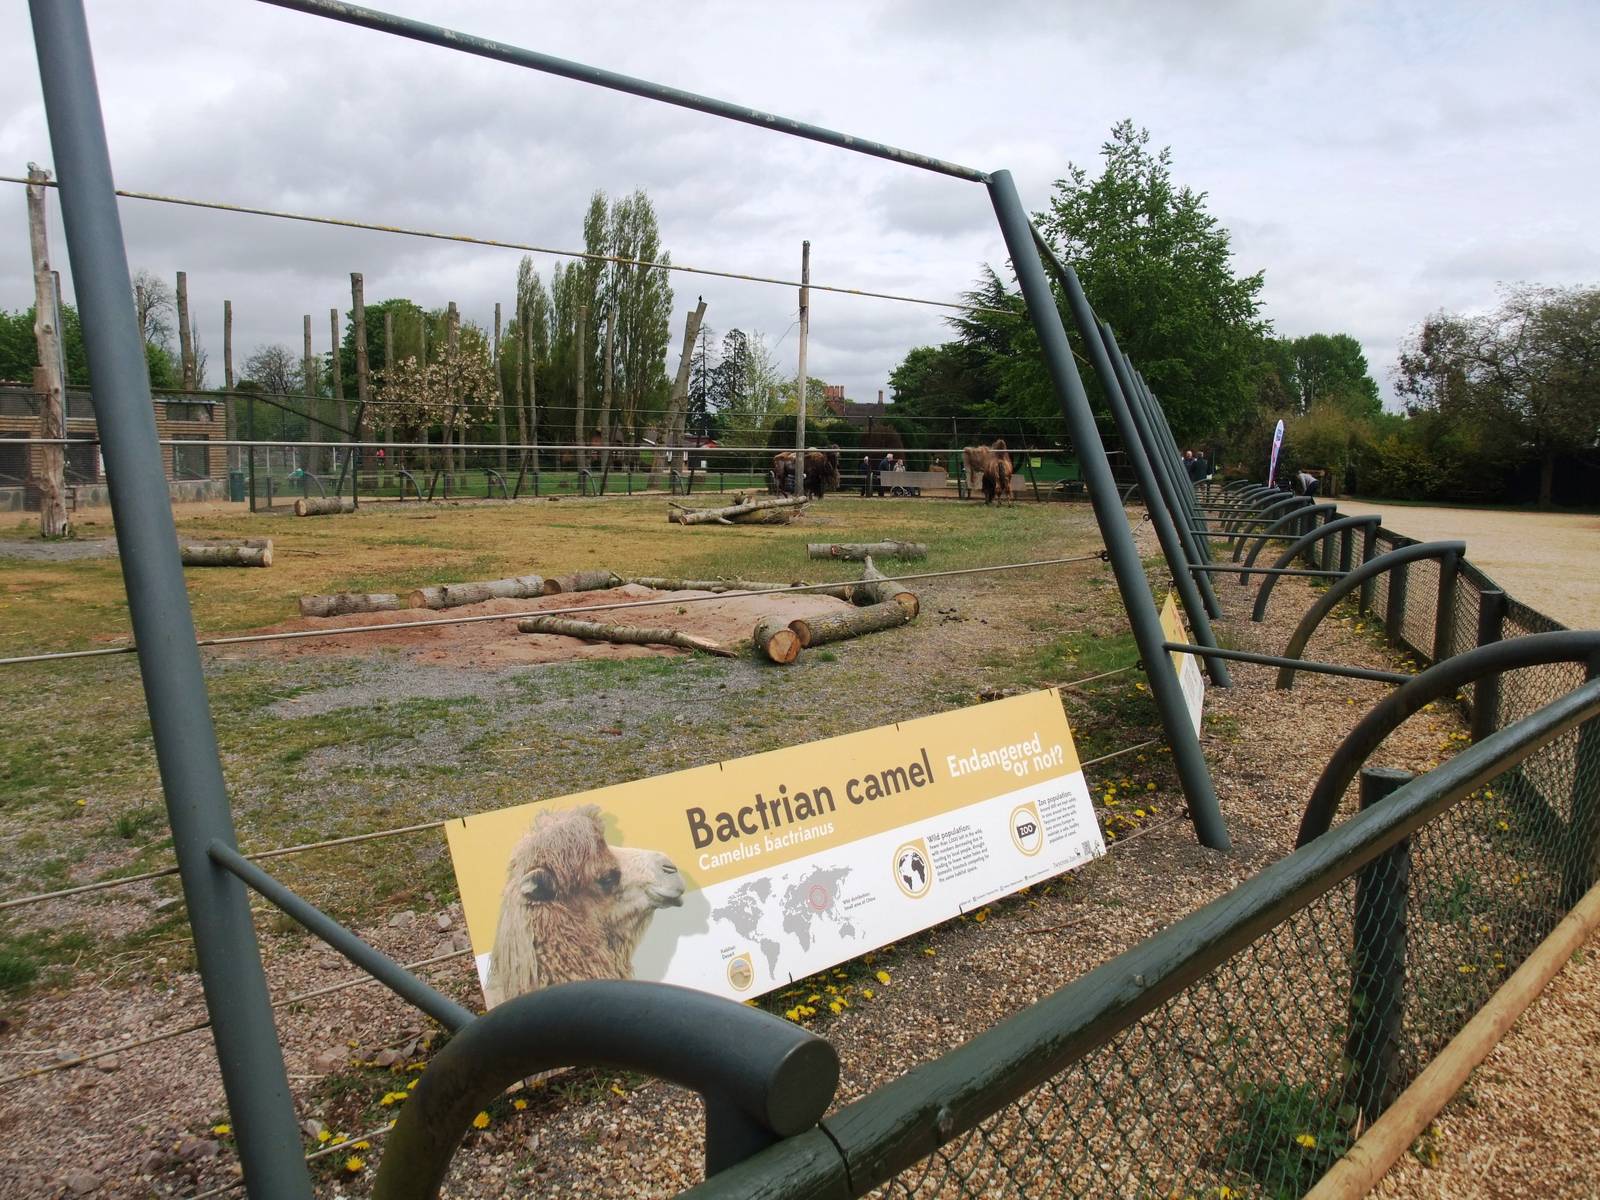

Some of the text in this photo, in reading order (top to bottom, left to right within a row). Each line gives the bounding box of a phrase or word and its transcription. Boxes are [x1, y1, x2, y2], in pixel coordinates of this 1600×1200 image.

[946, 731, 1042, 778] Endangered
[1013, 744, 1064, 777] or not?
[686, 747, 935, 850] Bactrian camel
[1047, 792, 1071, 803] population:
[698, 820, 834, 871] Camelus bactrianus
[927, 826, 970, 842] Wild population:
[1020, 825, 1033, 836] ZOO
